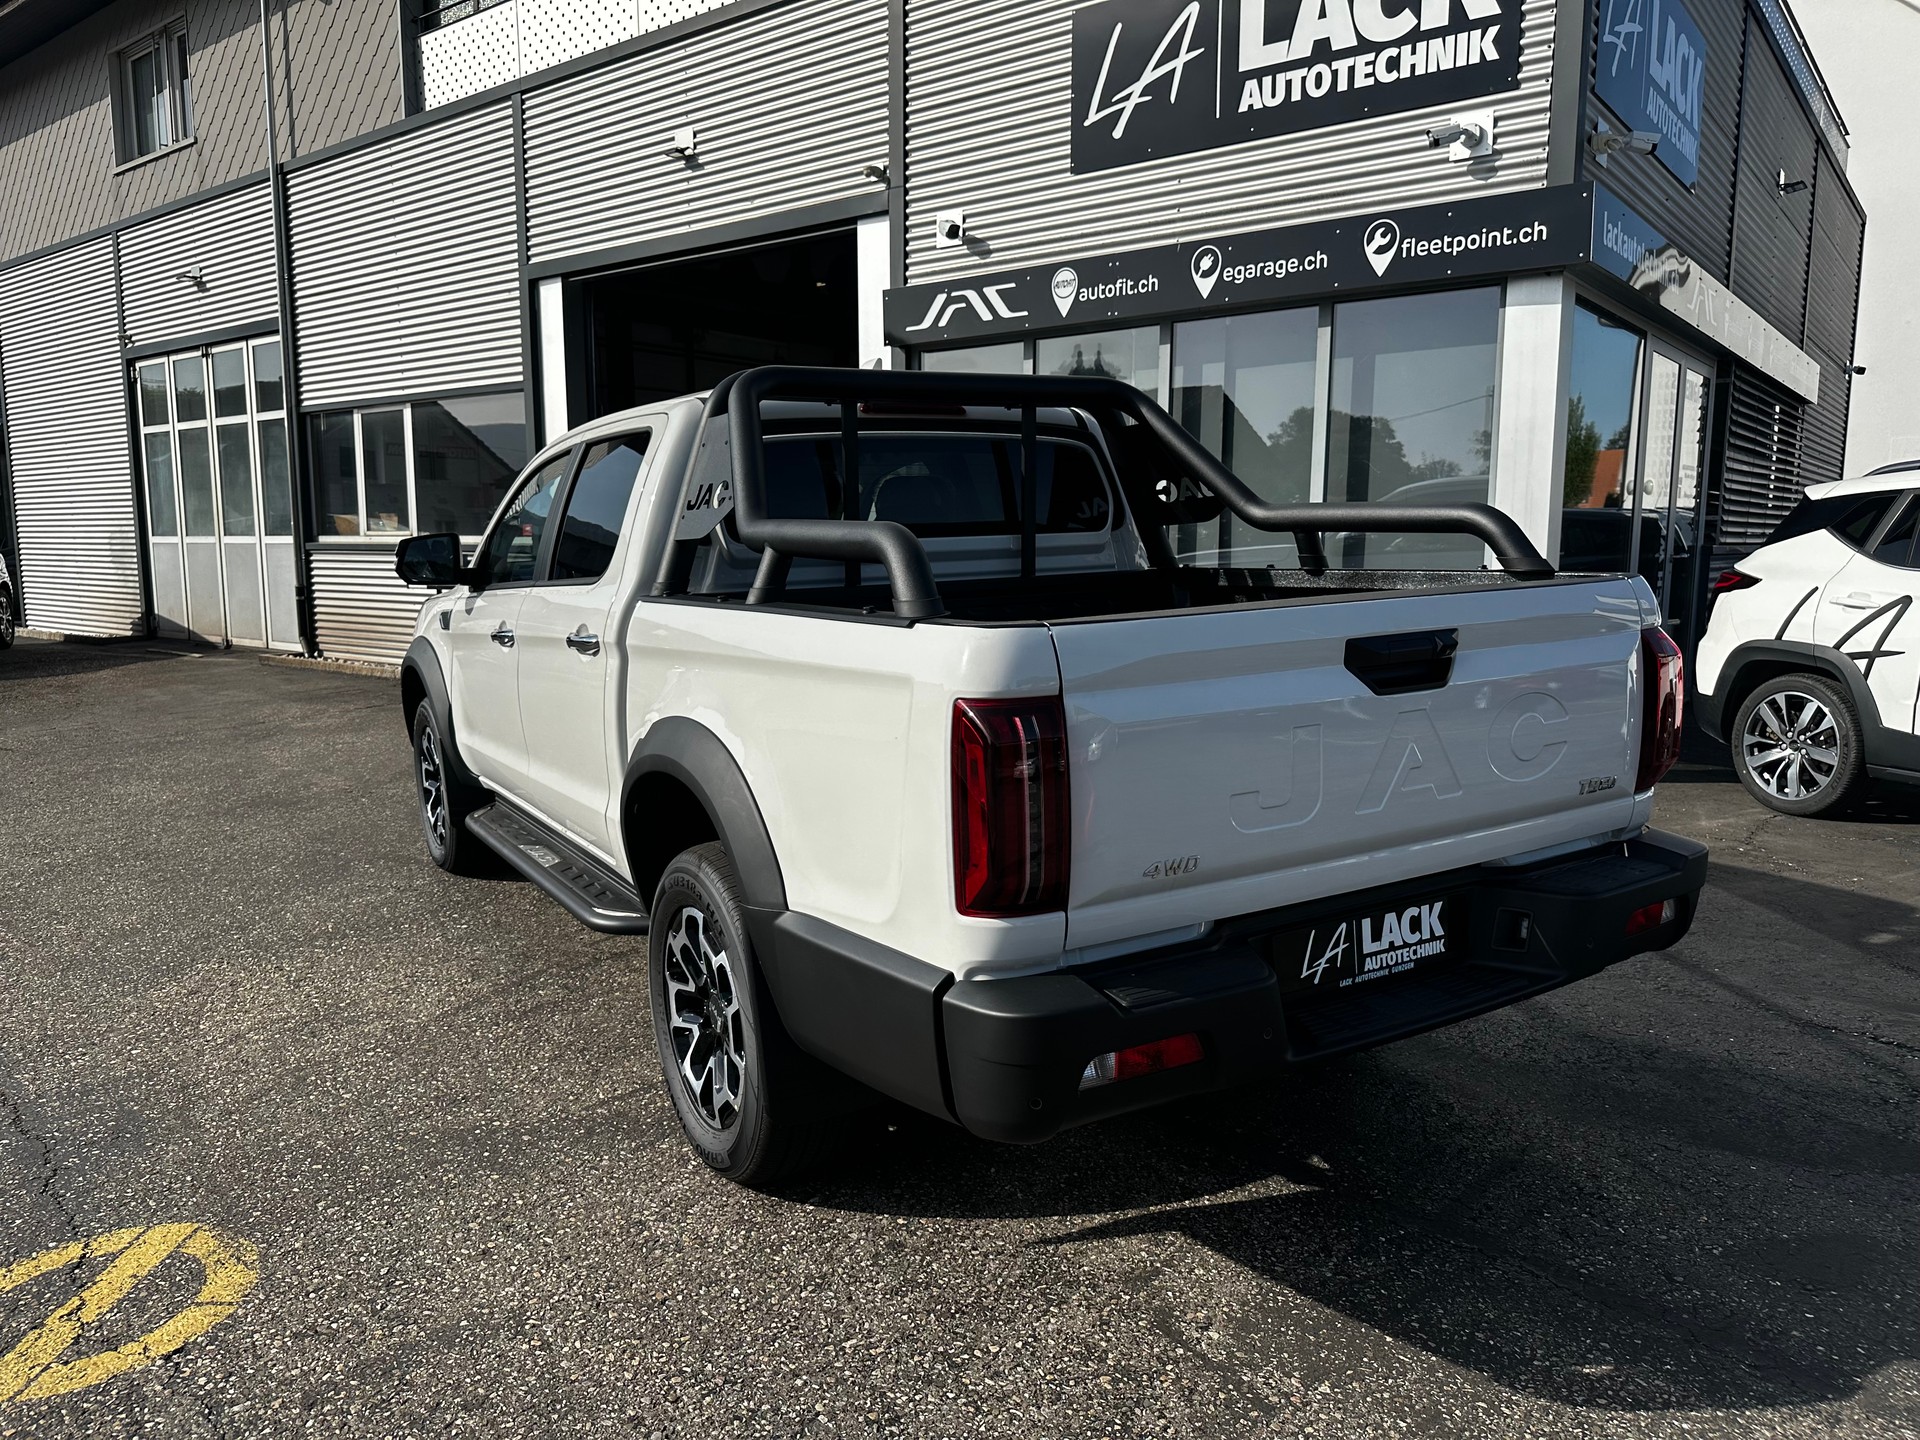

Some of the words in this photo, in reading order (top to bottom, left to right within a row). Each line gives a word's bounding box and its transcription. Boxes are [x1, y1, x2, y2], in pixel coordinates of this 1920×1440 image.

[1237, 24, 1502, 114] AUTOTECHNIK
[1649, 0, 1702, 133] LACK
[1646, 86, 1698, 167] AUTOTECHNIK
[1078, 274, 1159, 302] autofit.ch
[1222, 250, 1328, 285] egarage.ch
[1400, 221, 1548, 259] fleetpoint.ch
[686, 480, 730, 511] JAC
[1230, 691, 1570, 834] JAC
[1142, 854, 1200, 879] 4WD
[1361, 901, 1445, 955] LACK
[1364, 938, 1446, 972] AUTOTECHNIK
